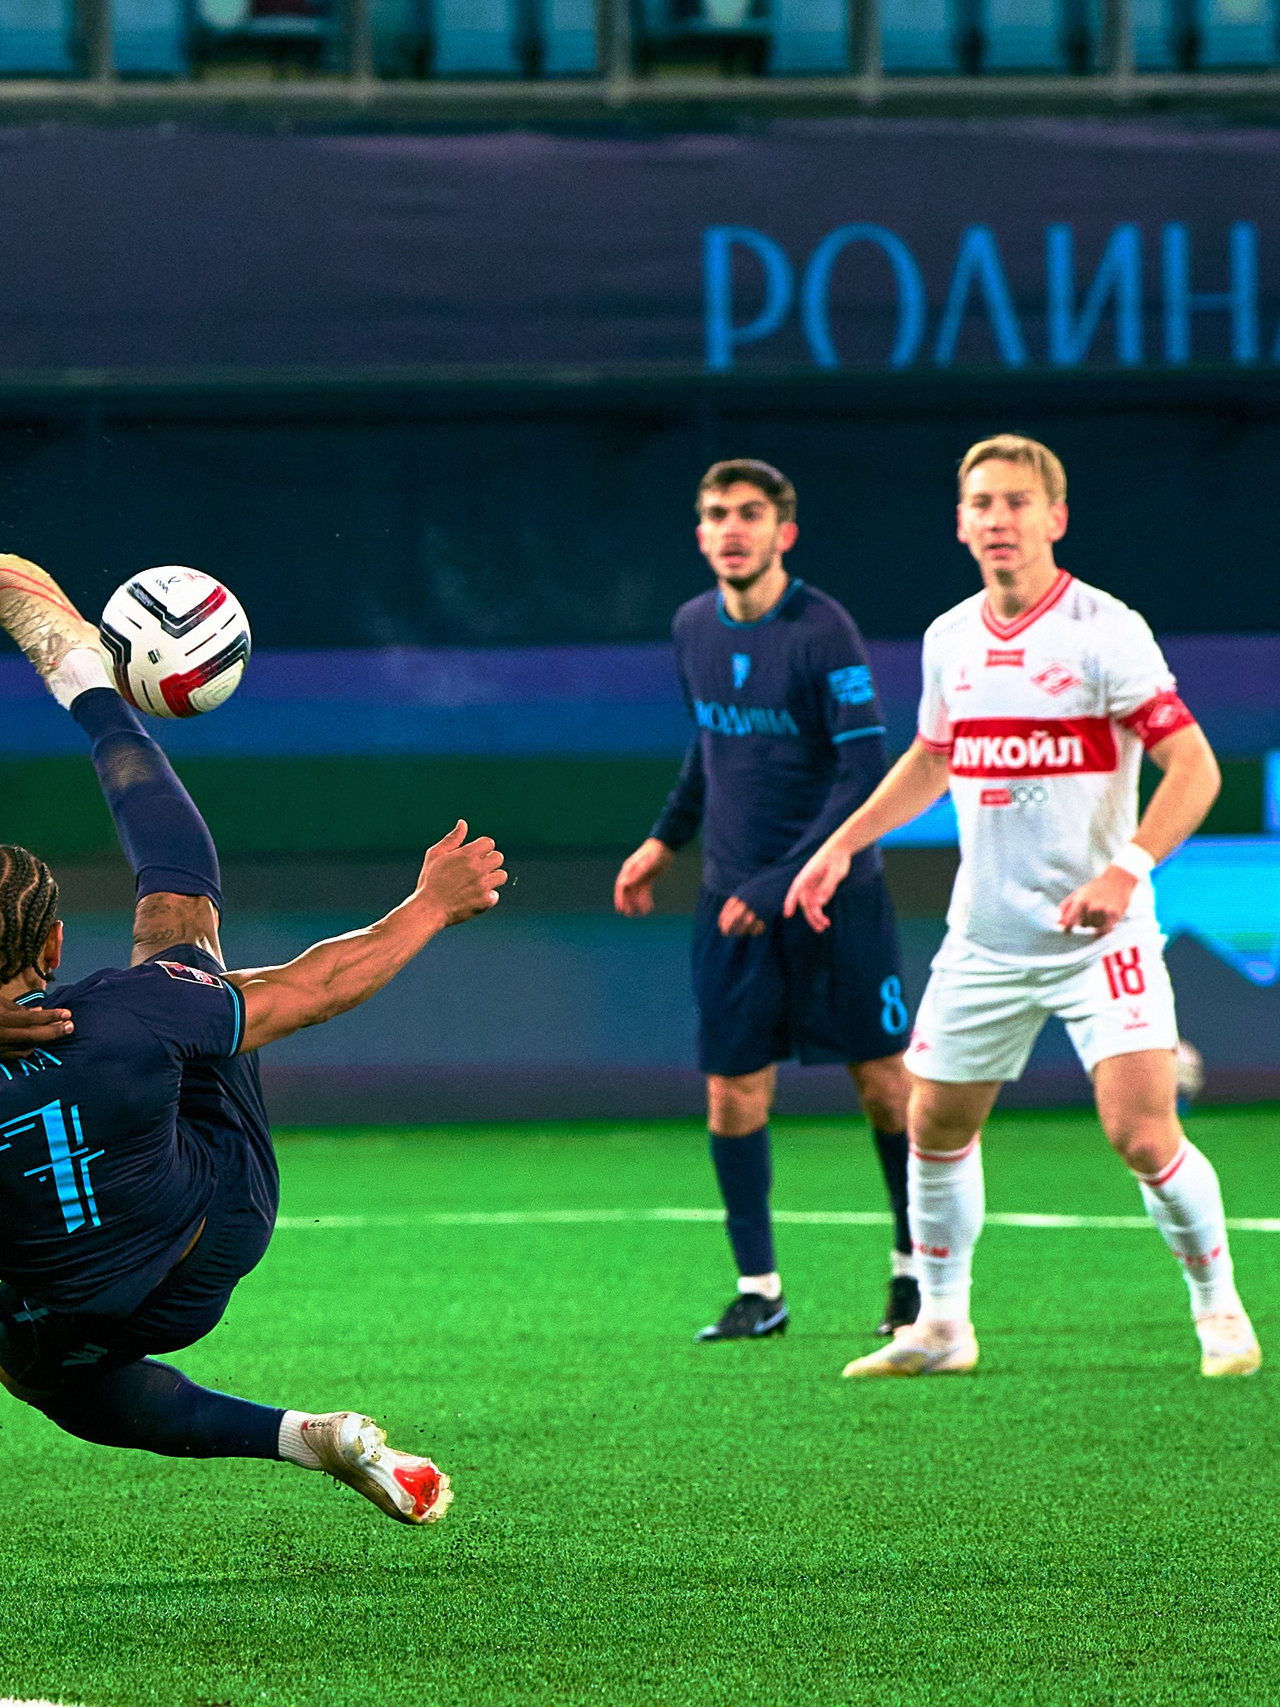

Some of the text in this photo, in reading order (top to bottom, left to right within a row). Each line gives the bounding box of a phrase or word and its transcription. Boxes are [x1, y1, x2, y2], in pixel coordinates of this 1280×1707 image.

[951, 730, 1085, 769] ЛУКОЙЛ
[1101, 945, 1146, 1000] 18
[880, 975, 909, 1035] 8
